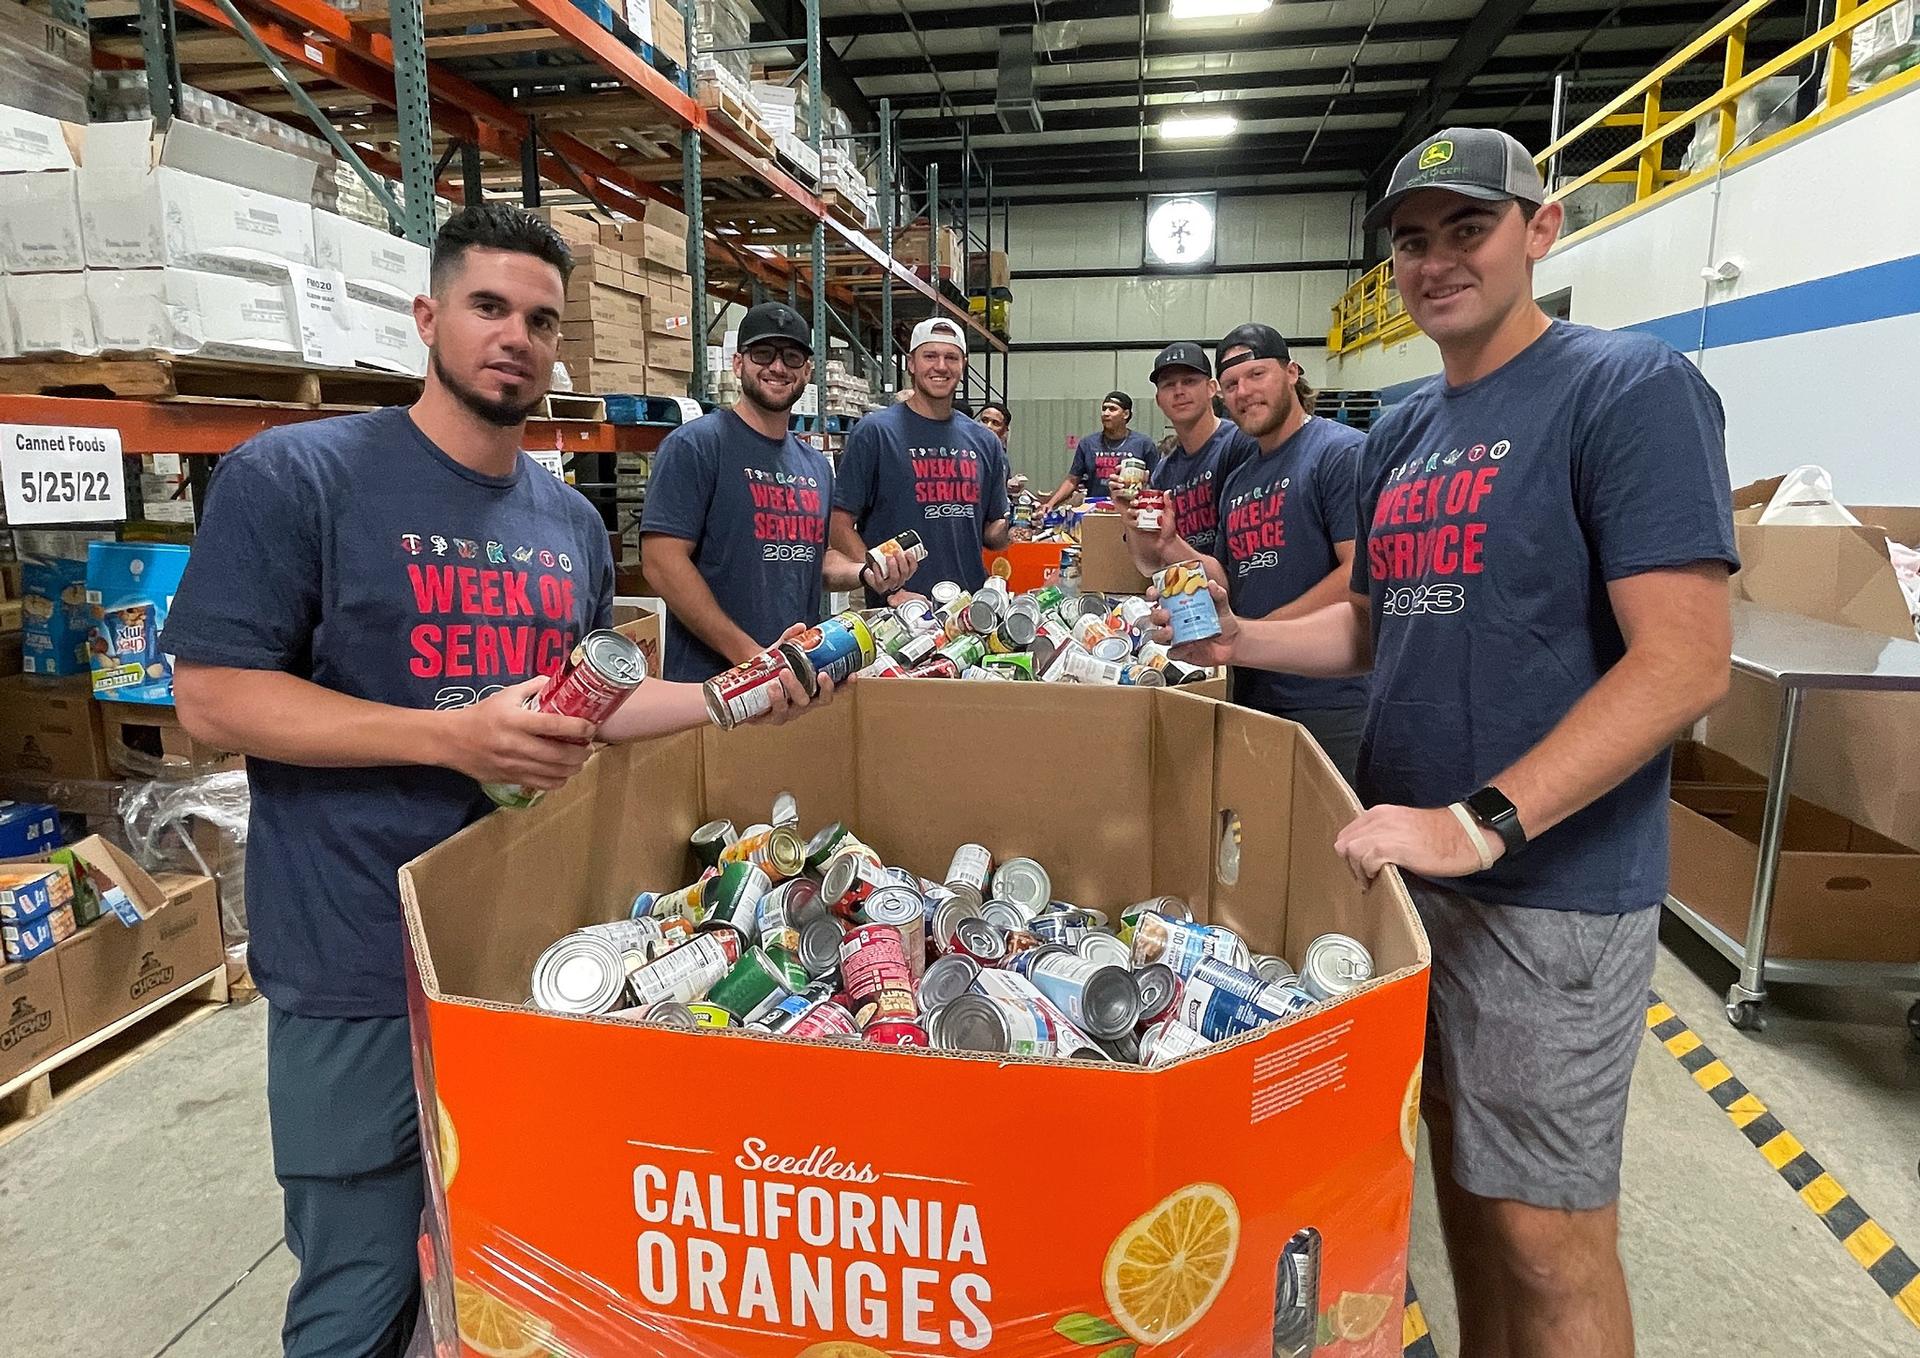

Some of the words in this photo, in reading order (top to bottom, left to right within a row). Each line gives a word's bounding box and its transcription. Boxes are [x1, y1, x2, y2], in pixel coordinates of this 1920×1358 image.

[16, 434, 65, 452] Canned
[69, 435, 106, 453] Foods
[912, 458, 957, 478] WEEK
[960, 459, 977, 478] OF
[20, 471, 111, 503] 5/25/22
[749, 482, 799, 513] WEEK
[1371, 475, 1446, 528] WEEK
[1445, 467, 1499, 516] OF
[754, 512, 824, 543] SERVICE
[925, 504, 974, 519] 2023
[763, 544, 816, 562] 2023
[407, 563, 534, 616] WEEK
[538, 573, 575, 623] OF
[130, 966, 174, 999] CHEWY
[0, 1010, 51, 1050] CHEWY
[734, 1136, 881, 1184] Seedless
[632, 1164, 988, 1266] CALIFORNIA
[636, 1230, 993, 1351] ORANGES
